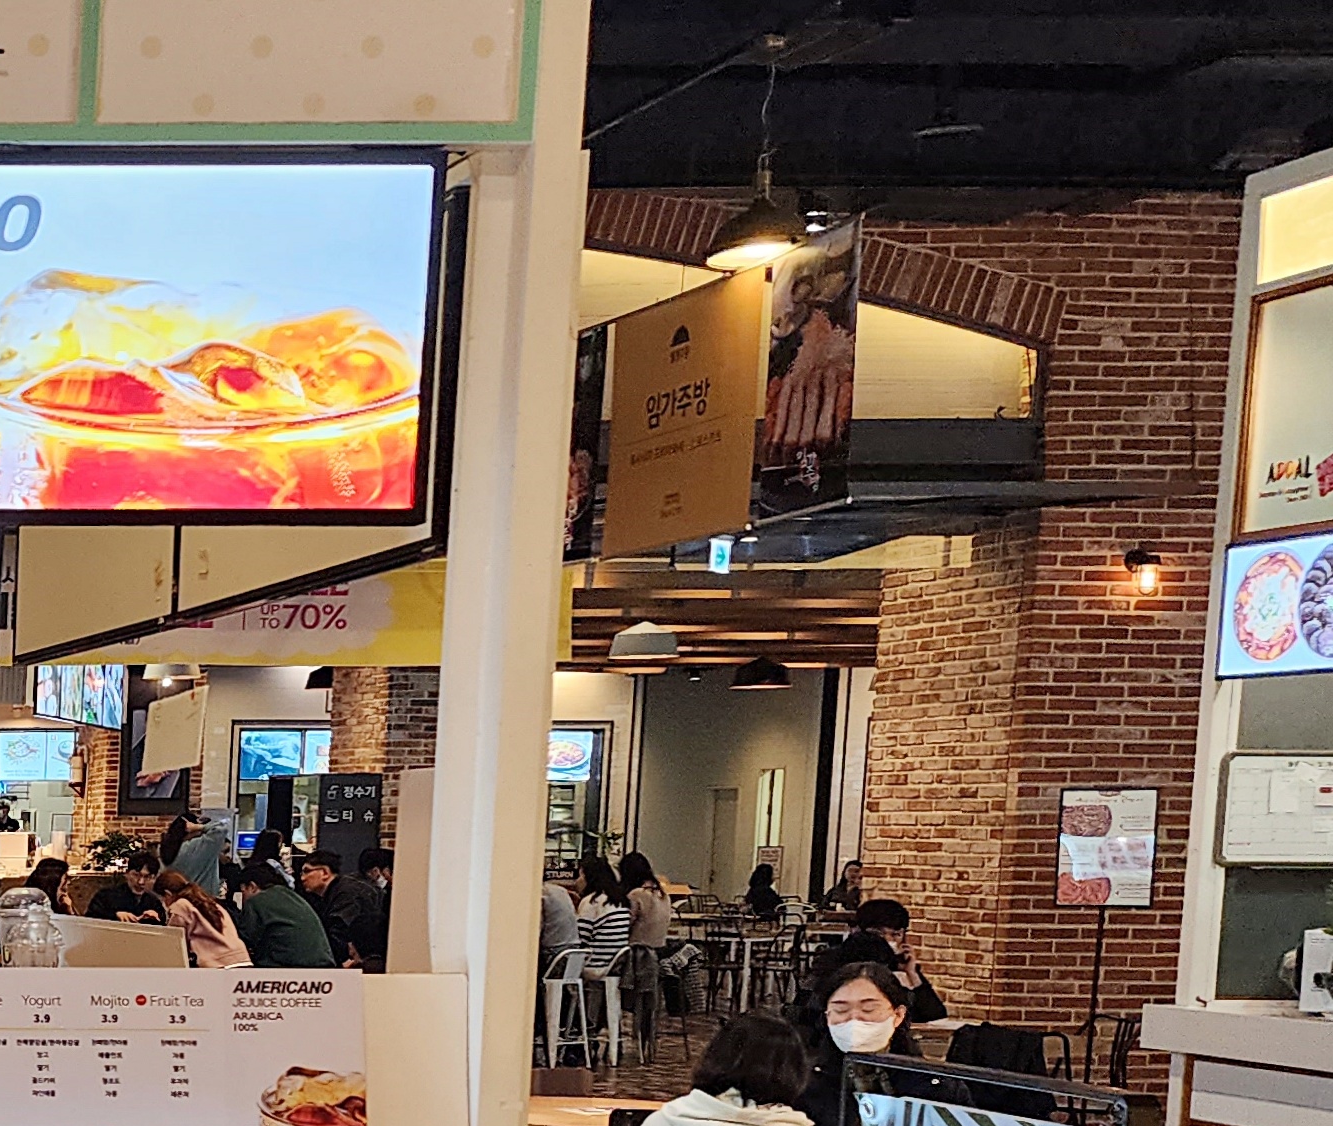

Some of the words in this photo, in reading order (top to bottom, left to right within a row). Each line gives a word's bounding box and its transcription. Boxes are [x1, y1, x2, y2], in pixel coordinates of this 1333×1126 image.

[646, 378, 710, 429] 임가주방
[261, 604, 280, 615] UP
[282, 604, 347, 630] 70%
[260, 618, 279, 629] TO
[343, 786, 376, 799] 정수기
[234, 981, 332, 995] AMERICANO
[22, 995, 61, 1009] Yogurt
[91, 995, 129, 1008] Mojito
[150, 995, 179, 1007] Fruit
[183, 996, 204, 1007] Tea
[233, 998, 277, 1008] JEJUICE
[281, 998, 322, 1008] COFFEE
[33, 1014, 51, 1023] 3.9
[101, 1014, 118, 1024] 3.9
[169, 1015, 186, 1024] 3.9
[233, 1012, 284, 1021] ARABICA
[234, 1023, 258, 1032] 100%
